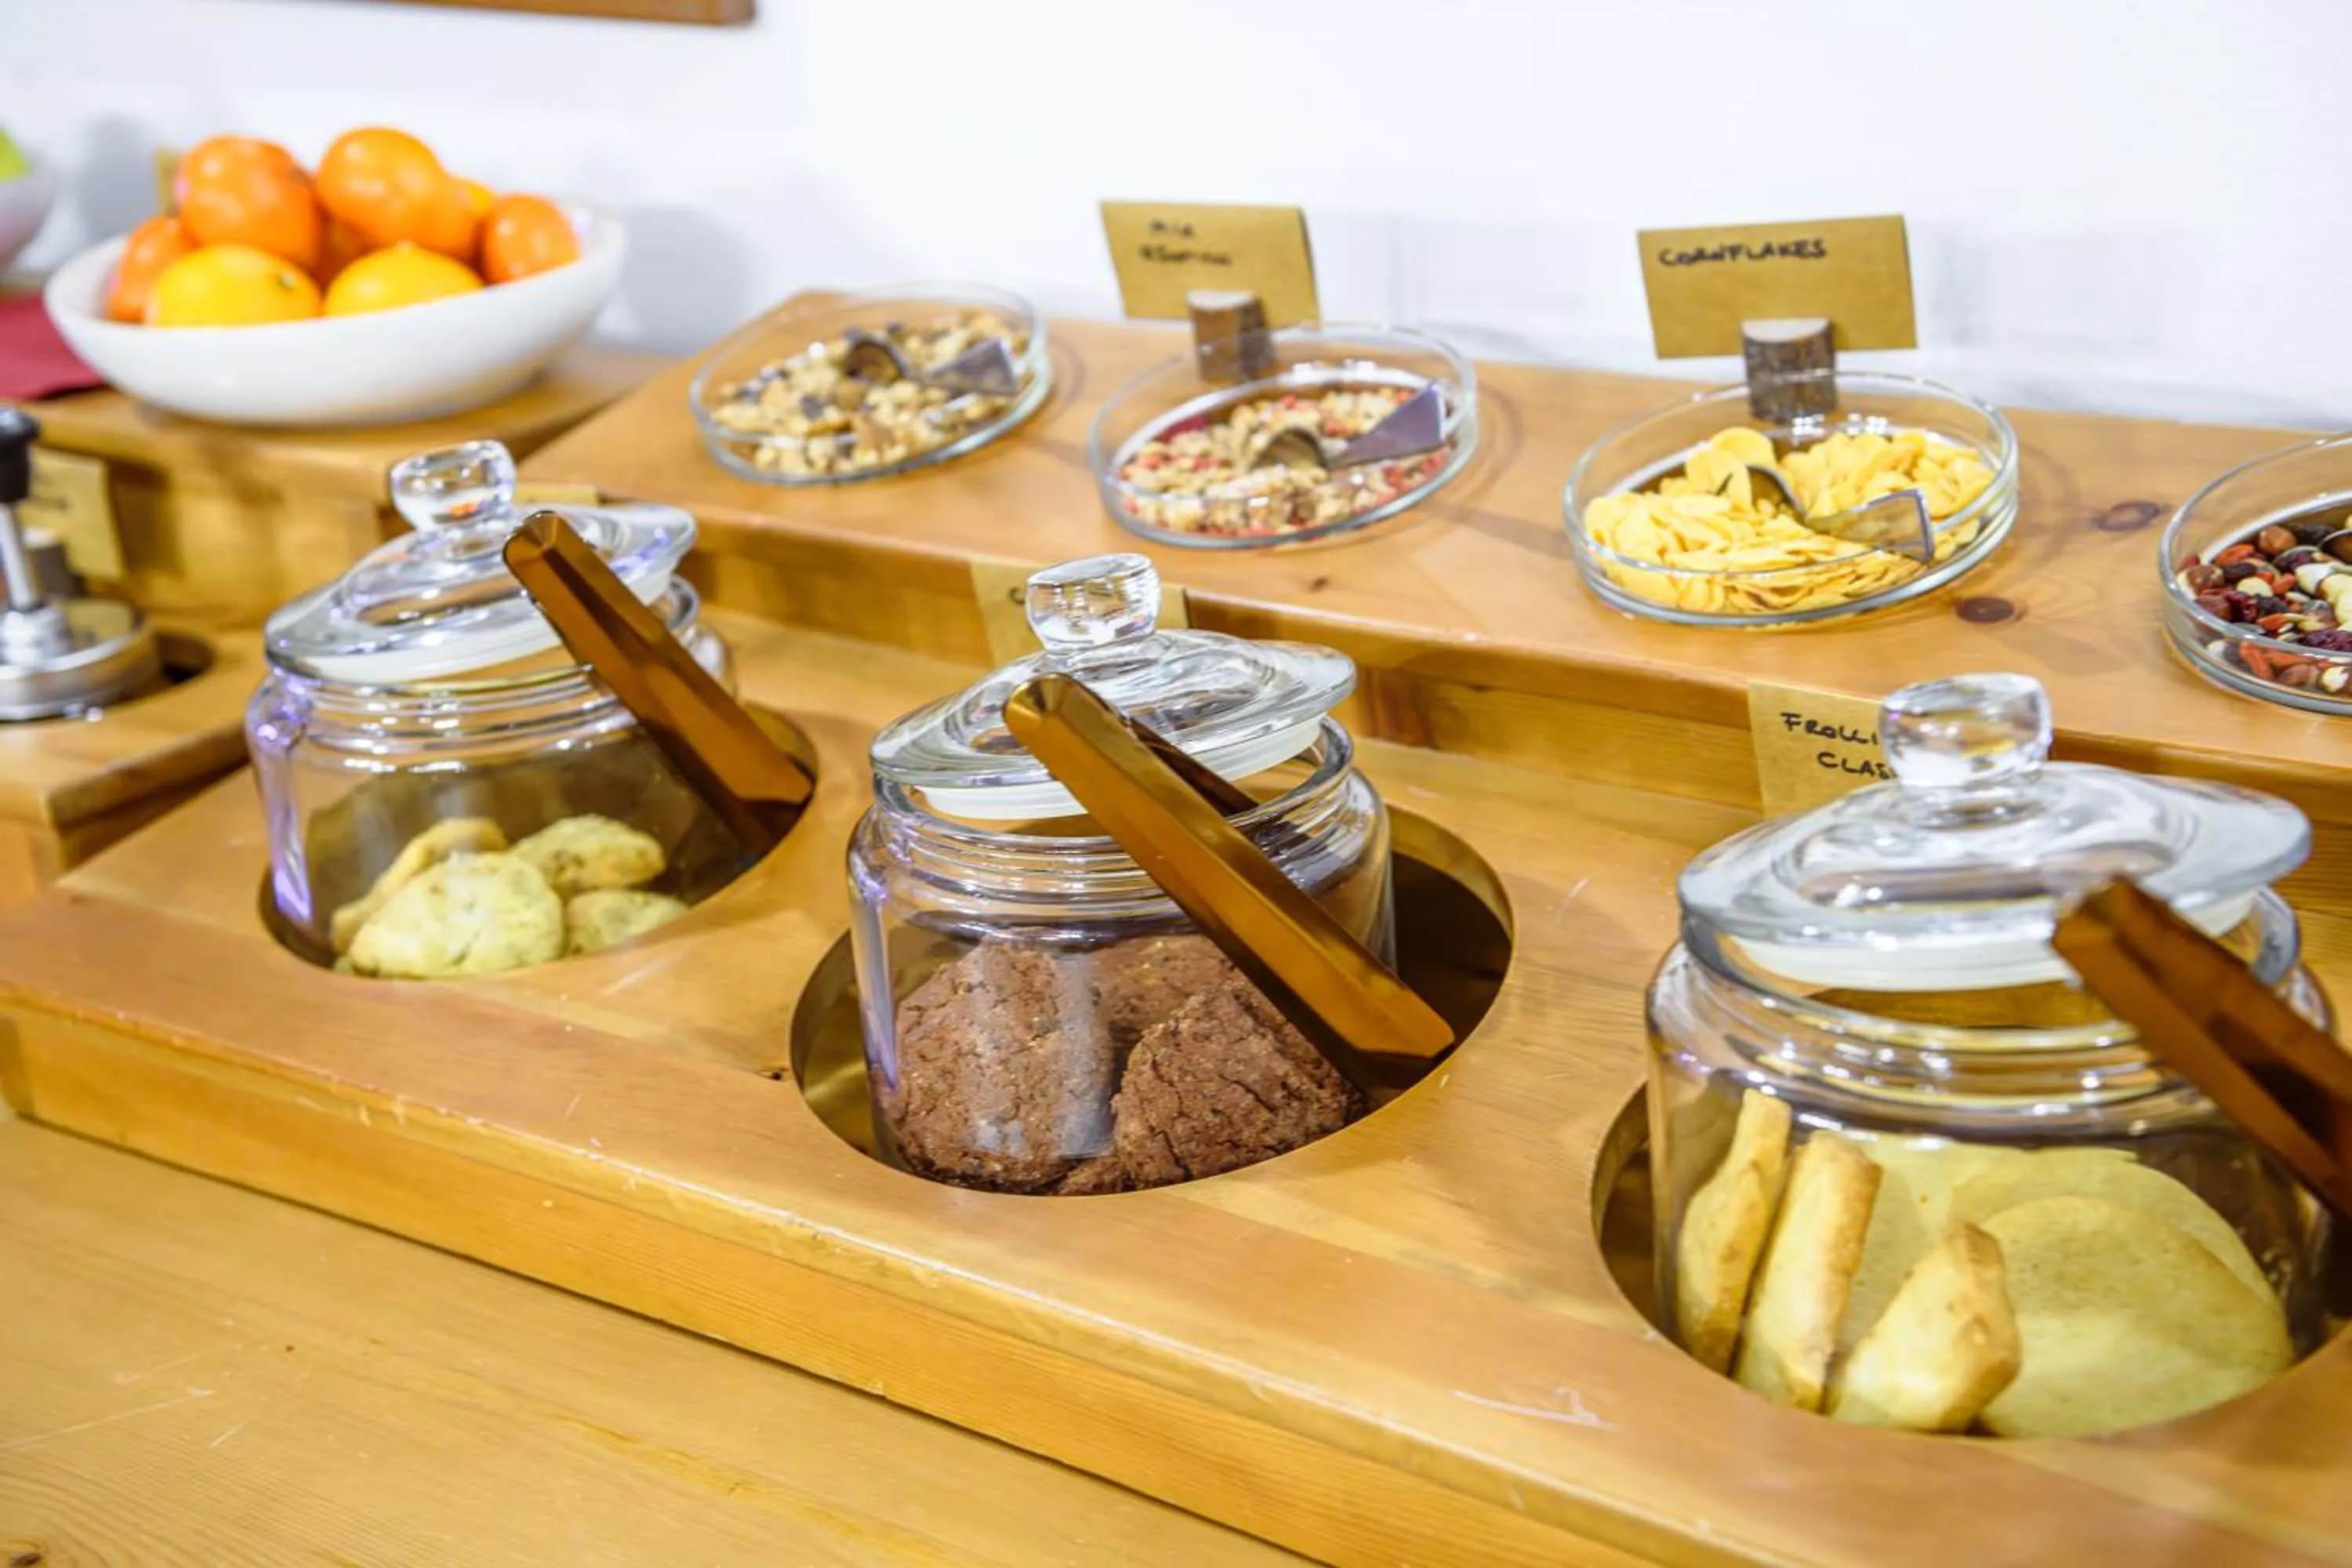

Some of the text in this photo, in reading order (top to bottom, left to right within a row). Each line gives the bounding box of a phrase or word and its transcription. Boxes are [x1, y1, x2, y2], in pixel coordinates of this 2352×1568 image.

[1658, 238, 1828, 267] CORNFLAKES
[1780, 711, 1878, 746] FROLLI
[1817, 750, 1897, 779] CLAS
